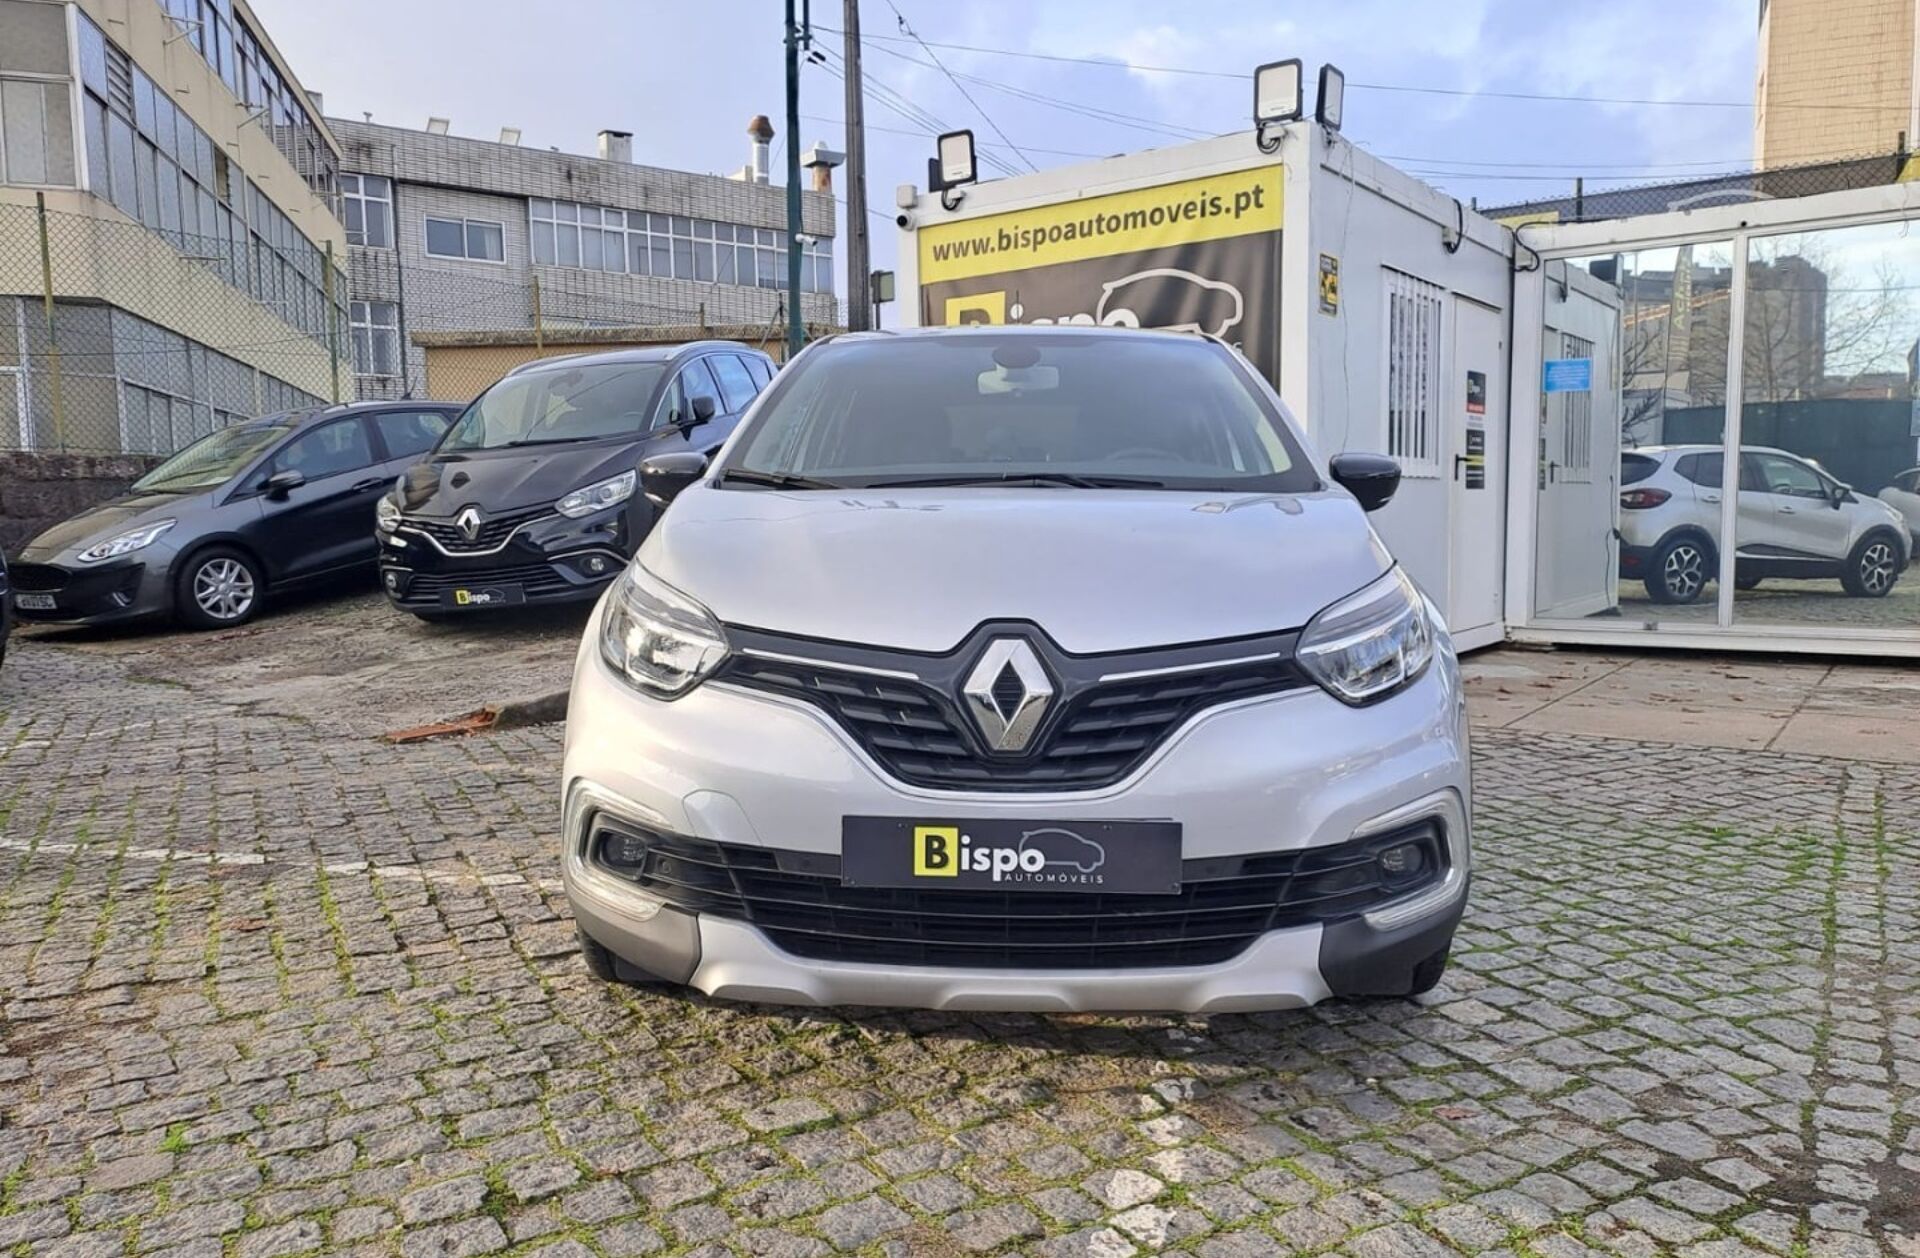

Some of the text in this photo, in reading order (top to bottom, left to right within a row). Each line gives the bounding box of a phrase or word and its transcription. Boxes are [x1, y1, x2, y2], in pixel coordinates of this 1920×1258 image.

[933, 184, 1265, 262] www.bispoautomoveis.pt
[925, 835, 1045, 882] Bispo
[1005, 872, 1104, 884] AUTOMÓVEIS
